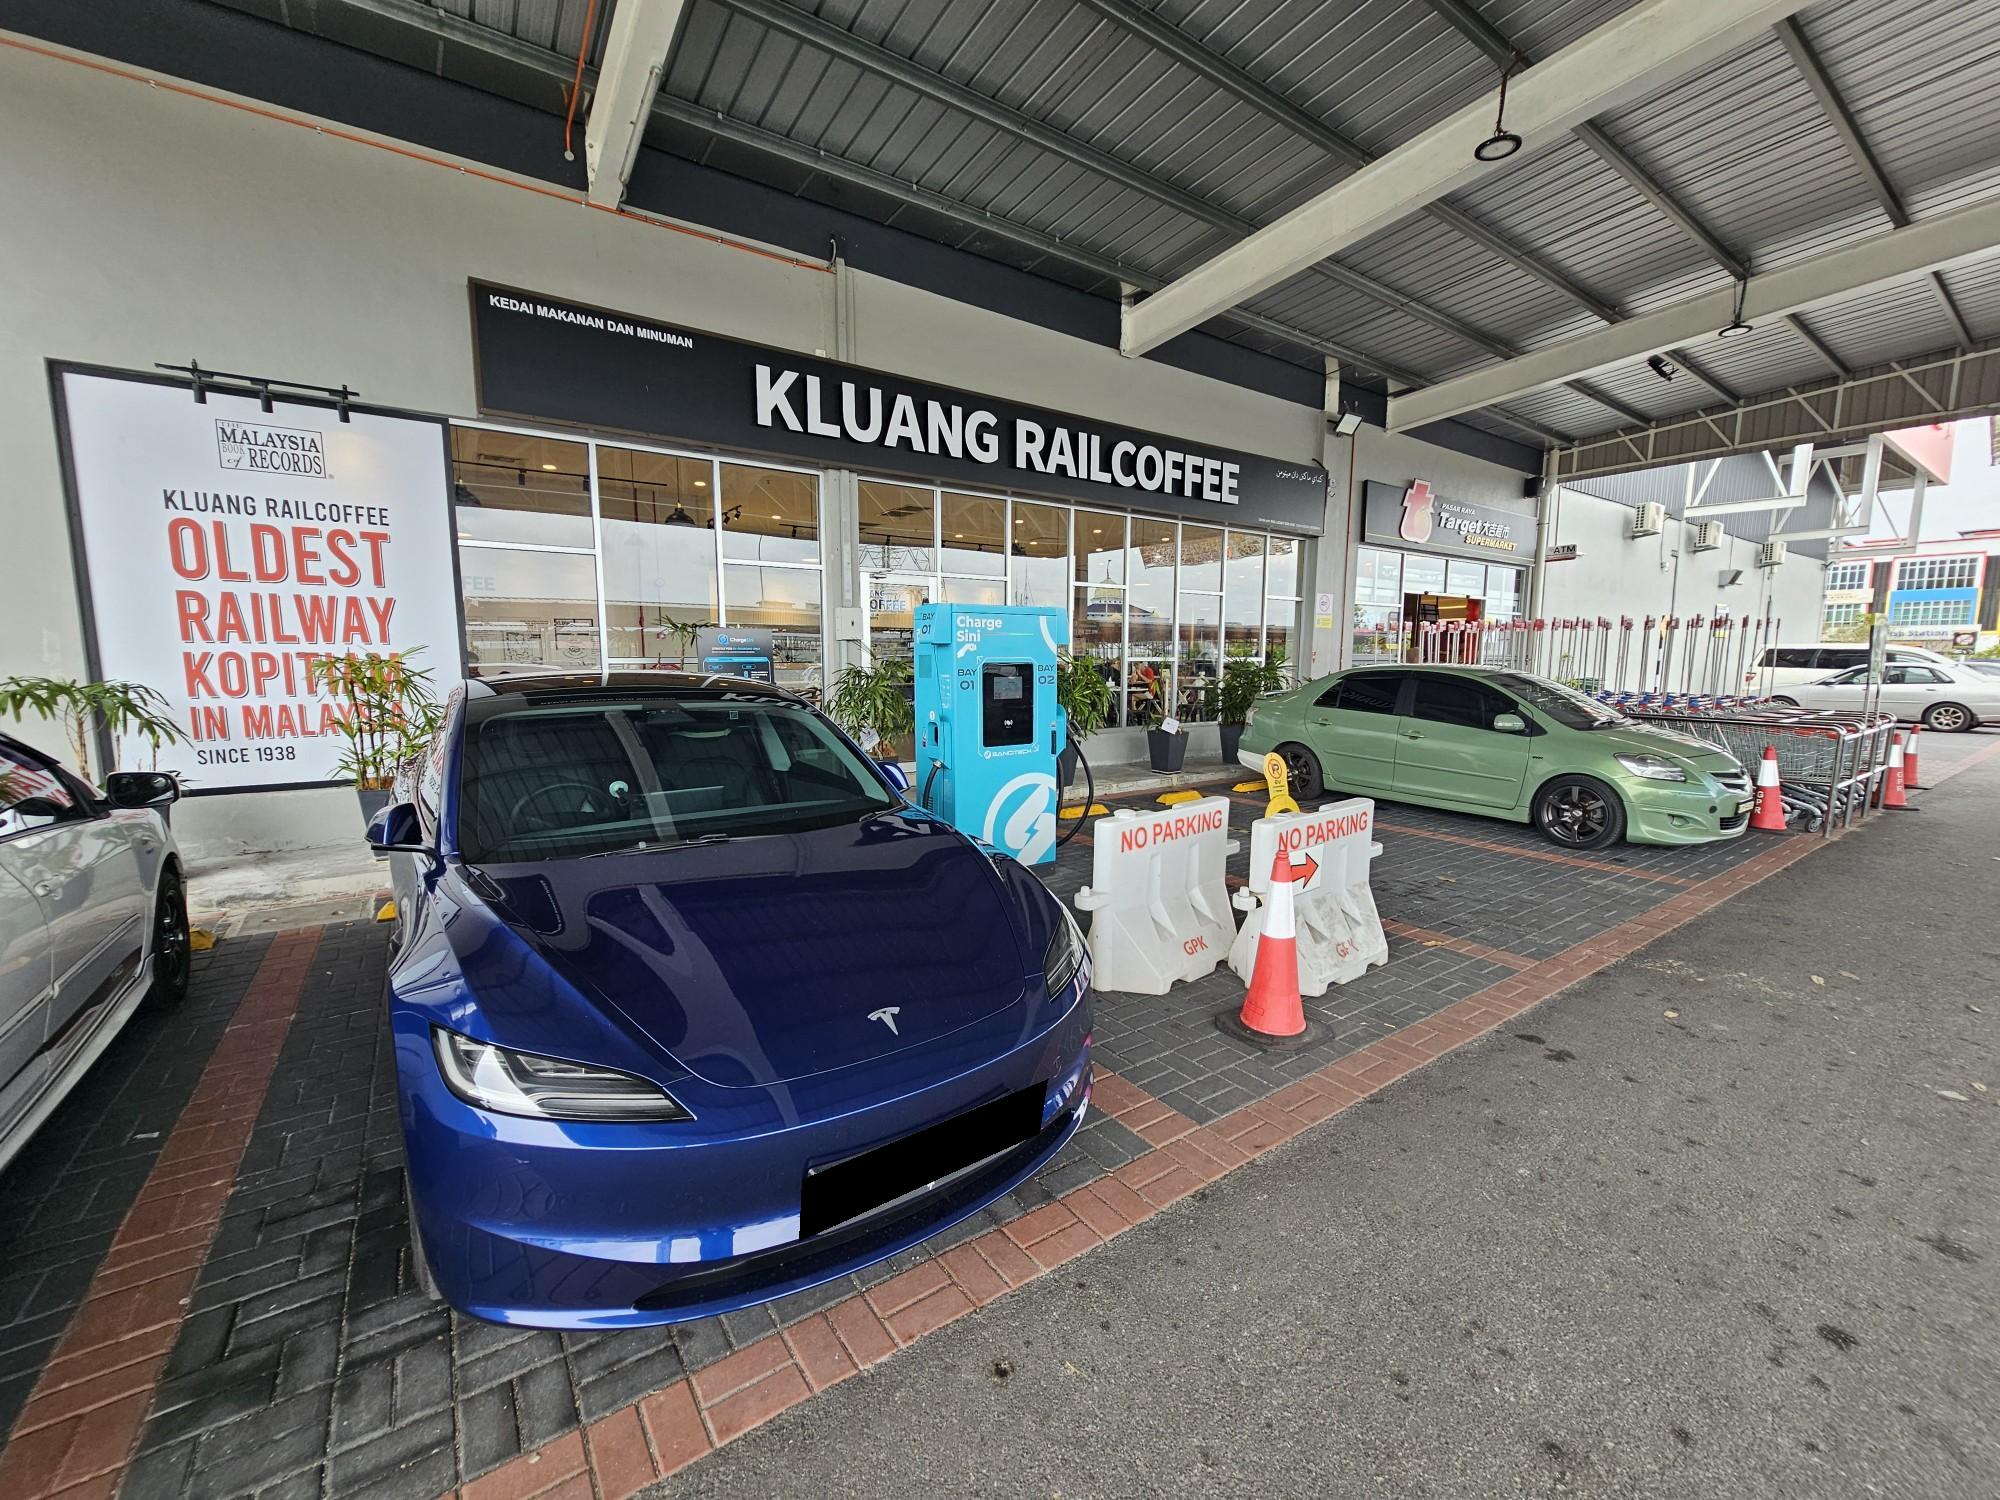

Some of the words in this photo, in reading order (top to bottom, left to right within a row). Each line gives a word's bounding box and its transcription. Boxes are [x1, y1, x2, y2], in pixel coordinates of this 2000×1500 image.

[489, 294, 533, 315] KEDAI
[536, 304, 604, 330] MAKANAN
[607, 319, 634, 336] DAN
[636, 326, 693, 349] MINUMAN
[219, 427, 321, 453] MALAYSIA
[755, 363, 999, 465] KLUANG
[1015, 418, 1240, 505] RAILCOFFEE
[222, 443, 246, 455] BOOK
[247, 447, 323, 475] RECORDS
[163, 488, 257, 516] KLUANG
[265, 497, 390, 527] RAILCOFFEE
[1442, 503, 1460, 512] PASAR
[1460, 507, 1476, 515] RAYA
[1440, 511, 1482, 535] Target
[1464, 534, 1518, 551] SUPERMARKET
[1553, 544, 1577, 555] ATM
[168, 517, 391, 589] OLDEST
[175, 590, 396, 645] RAILWAY
[922, 612, 935, 621] BAY
[956, 616, 1003, 630] Charge
[921, 624, 932, 634] 01
[956, 630, 981, 642] Sini
[957, 668, 977, 677] BAY
[1037, 664, 1055, 672] BAY
[960, 681, 975, 691] 01
[1038, 675, 1055, 685] 02
[189, 705, 230, 742] IN
[241, 702, 408, 741] MALAYSA
[197, 748, 250, 765] SINCE
[255, 745, 296, 762] 1938
[1753, 790, 1764, 815] GPR
[1120, 826, 1148, 853] NO
[1152, 809, 1223, 845] PARKING
[1278, 826, 1302, 851] NO
[1306, 810, 1368, 847] PARKING
[1183, 935, 1208, 956] GPK
